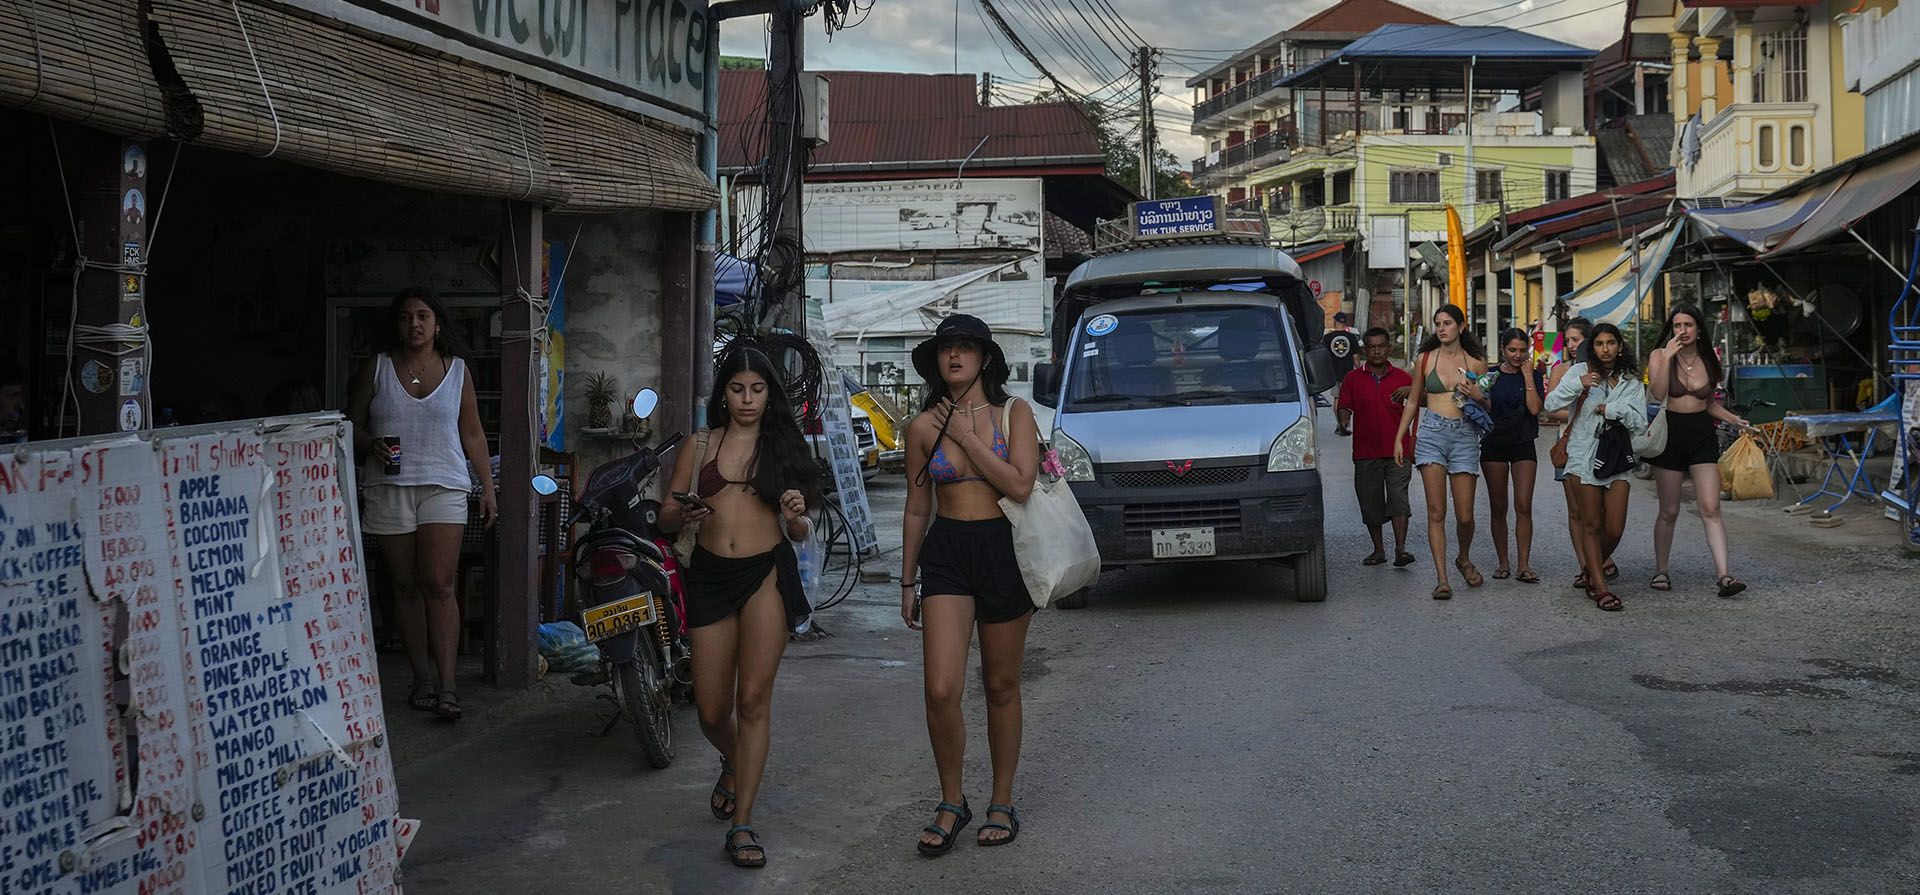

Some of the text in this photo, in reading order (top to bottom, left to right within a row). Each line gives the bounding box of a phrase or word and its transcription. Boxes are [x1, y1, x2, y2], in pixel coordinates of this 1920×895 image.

[615, 0, 705, 90] Place
[1141, 222, 1214, 236] TUK TUK SERVICE
[179, 474, 220, 499] APPLE
[180, 495, 249, 524] BANANA
[187, 543, 245, 573] LEMON
[191, 565, 246, 596] MELON
[196, 612, 252, 645] LEMON
[200, 632, 262, 668] ORANGE
[203, 648, 289, 692] PINEAPPLE
[207, 666, 311, 717] STRAWBERY
[214, 726, 275, 764] MANGO
[217, 757, 254, 789] MILO
[299, 751, 336, 782] MILK
[221, 794, 282, 838] COFFEE
[299, 771, 358, 806] PEANUT
[224, 816, 286, 862] CARROT
[300, 786, 360, 830] ORENGE
[337, 819, 388, 859] YOGURT
[227, 823, 327, 887] MIXED FRUIT
